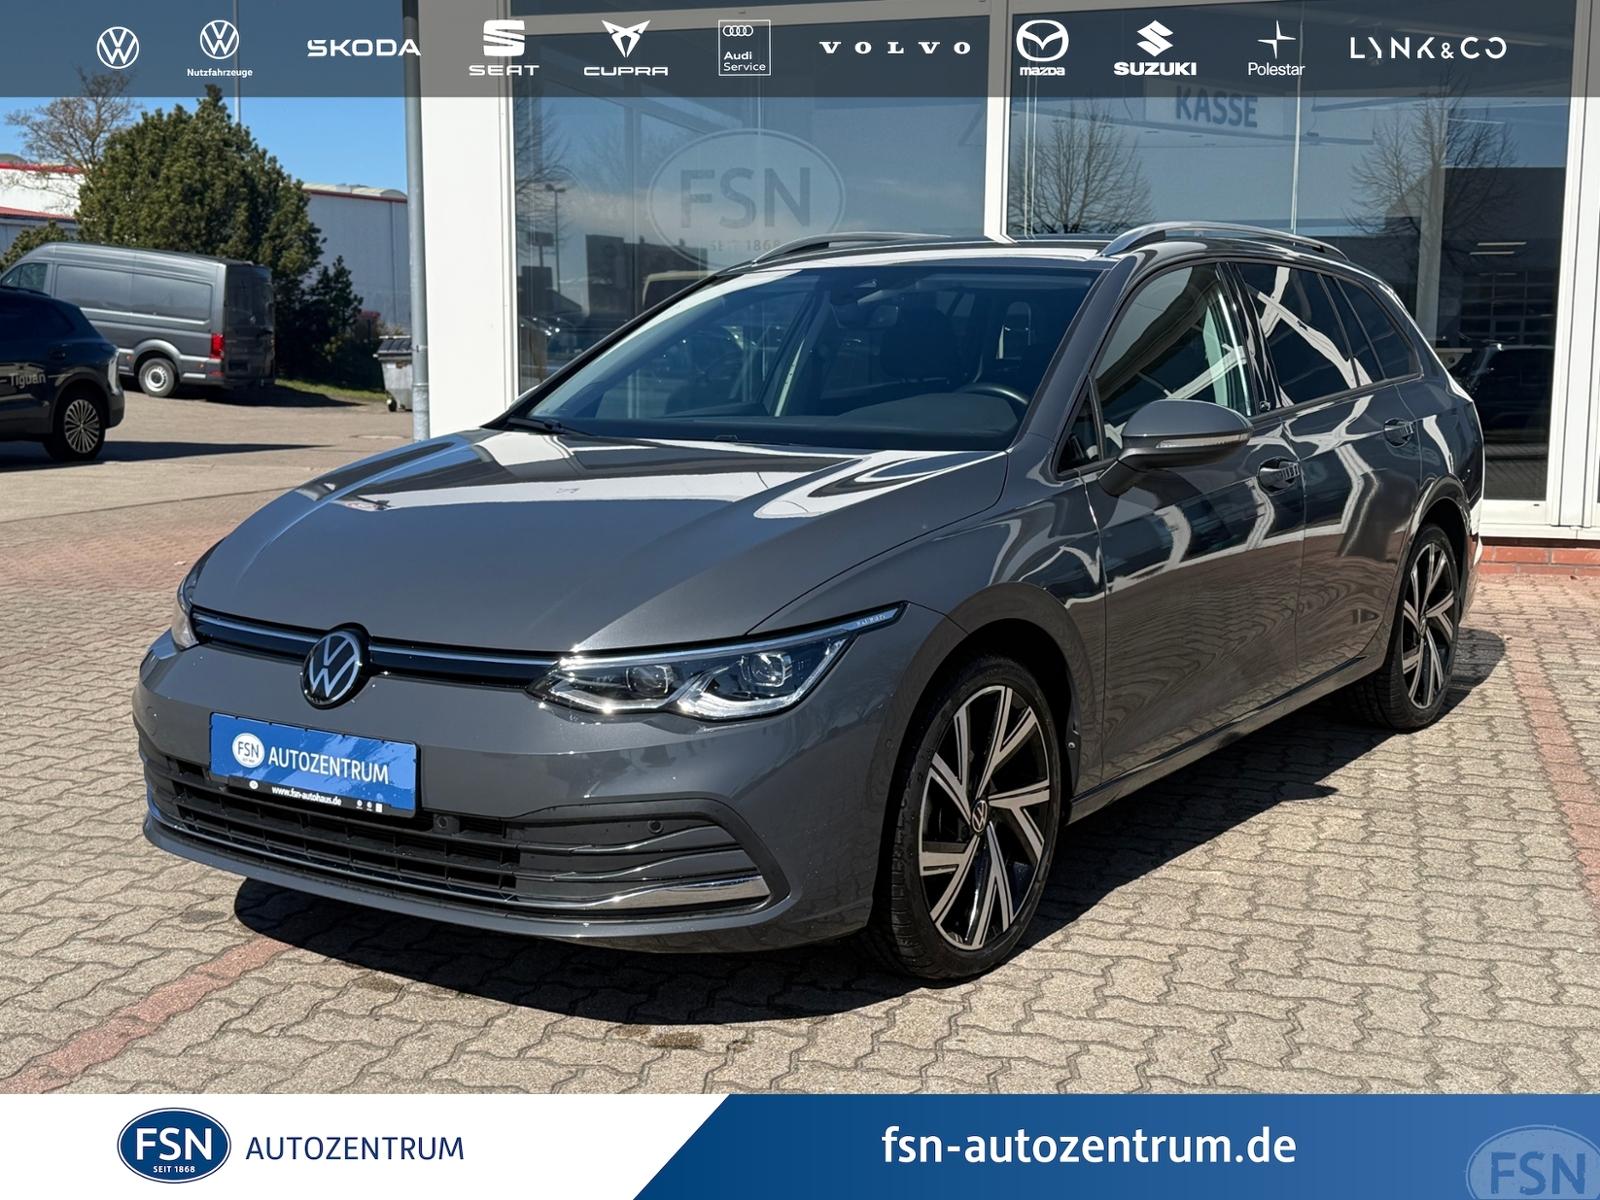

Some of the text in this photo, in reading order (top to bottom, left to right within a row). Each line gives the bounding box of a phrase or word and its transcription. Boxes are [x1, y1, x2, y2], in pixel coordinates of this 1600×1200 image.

[1176, 86, 1258, 128] KASSE
[680, 167, 811, 229] FSN
[9, 372, 47, 389] Tiguan
[237, 741, 260, 759] FSN
[268, 746, 389, 785] AUTOZENTRUM
[271, 786, 343, 807] www.fsn-autohaus.de
